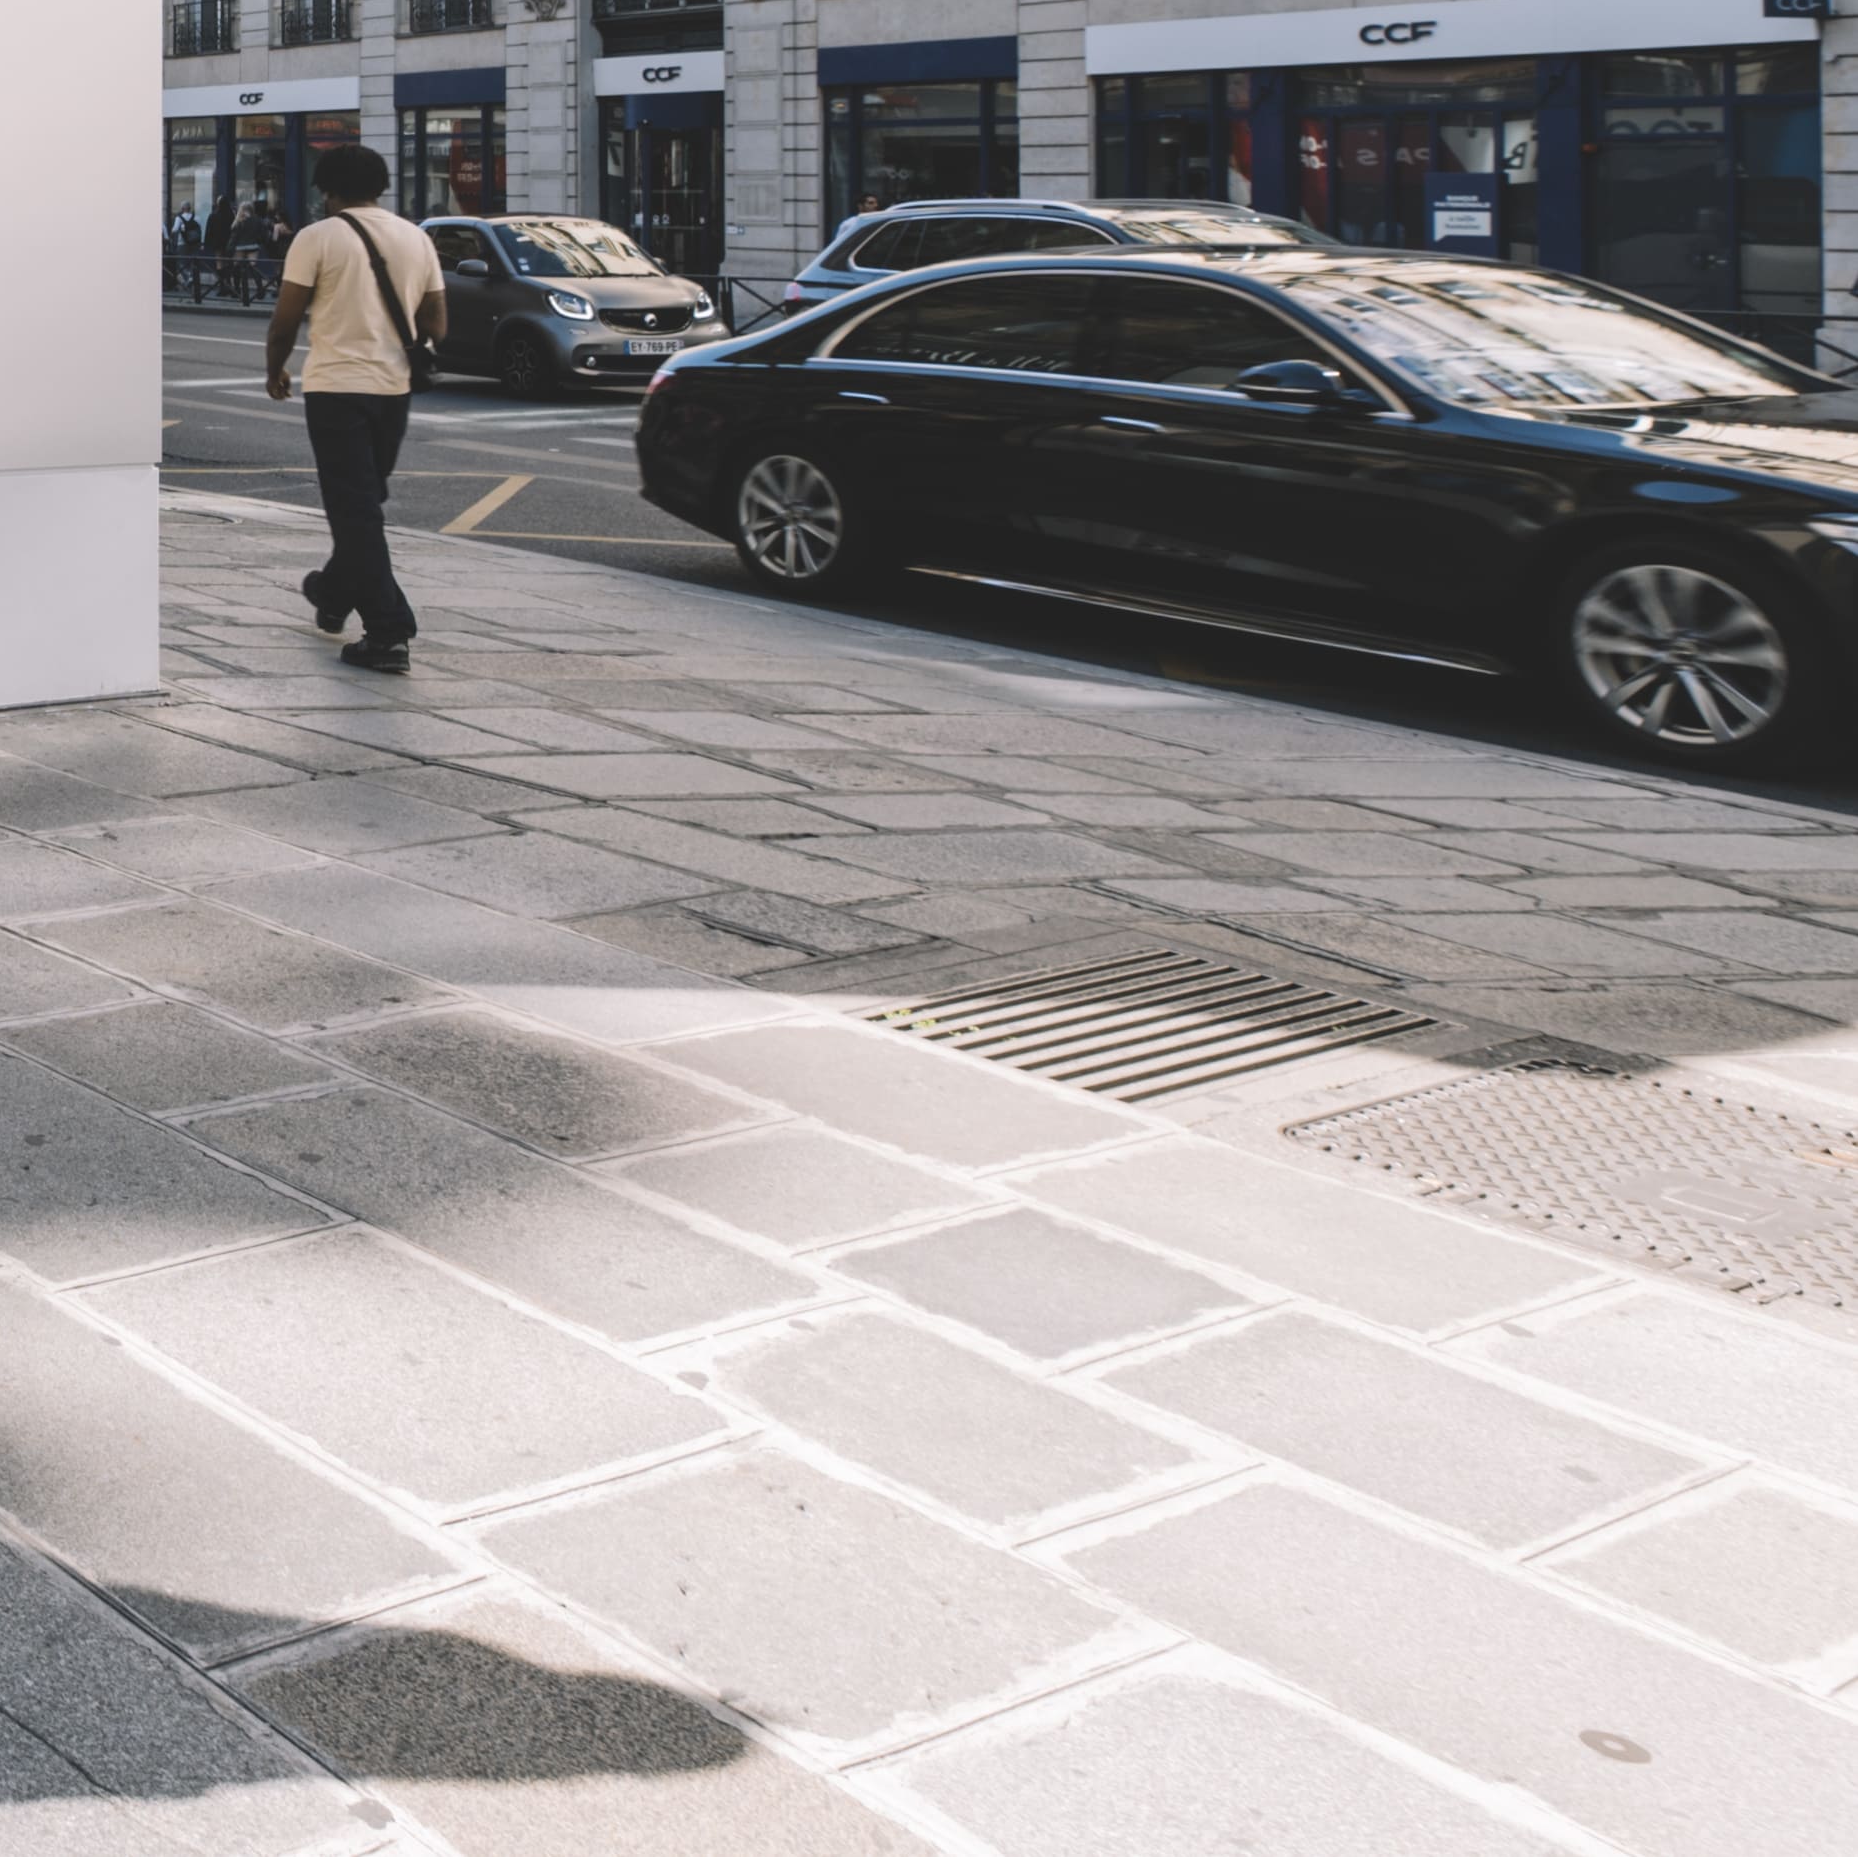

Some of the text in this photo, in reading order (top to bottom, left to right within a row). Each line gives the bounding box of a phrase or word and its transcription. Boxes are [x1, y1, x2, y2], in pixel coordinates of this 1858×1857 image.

[1359, 21, 1437, 45] CCF
[642, 66, 682, 83] CCF
[239, 93, 264, 105] CCF
